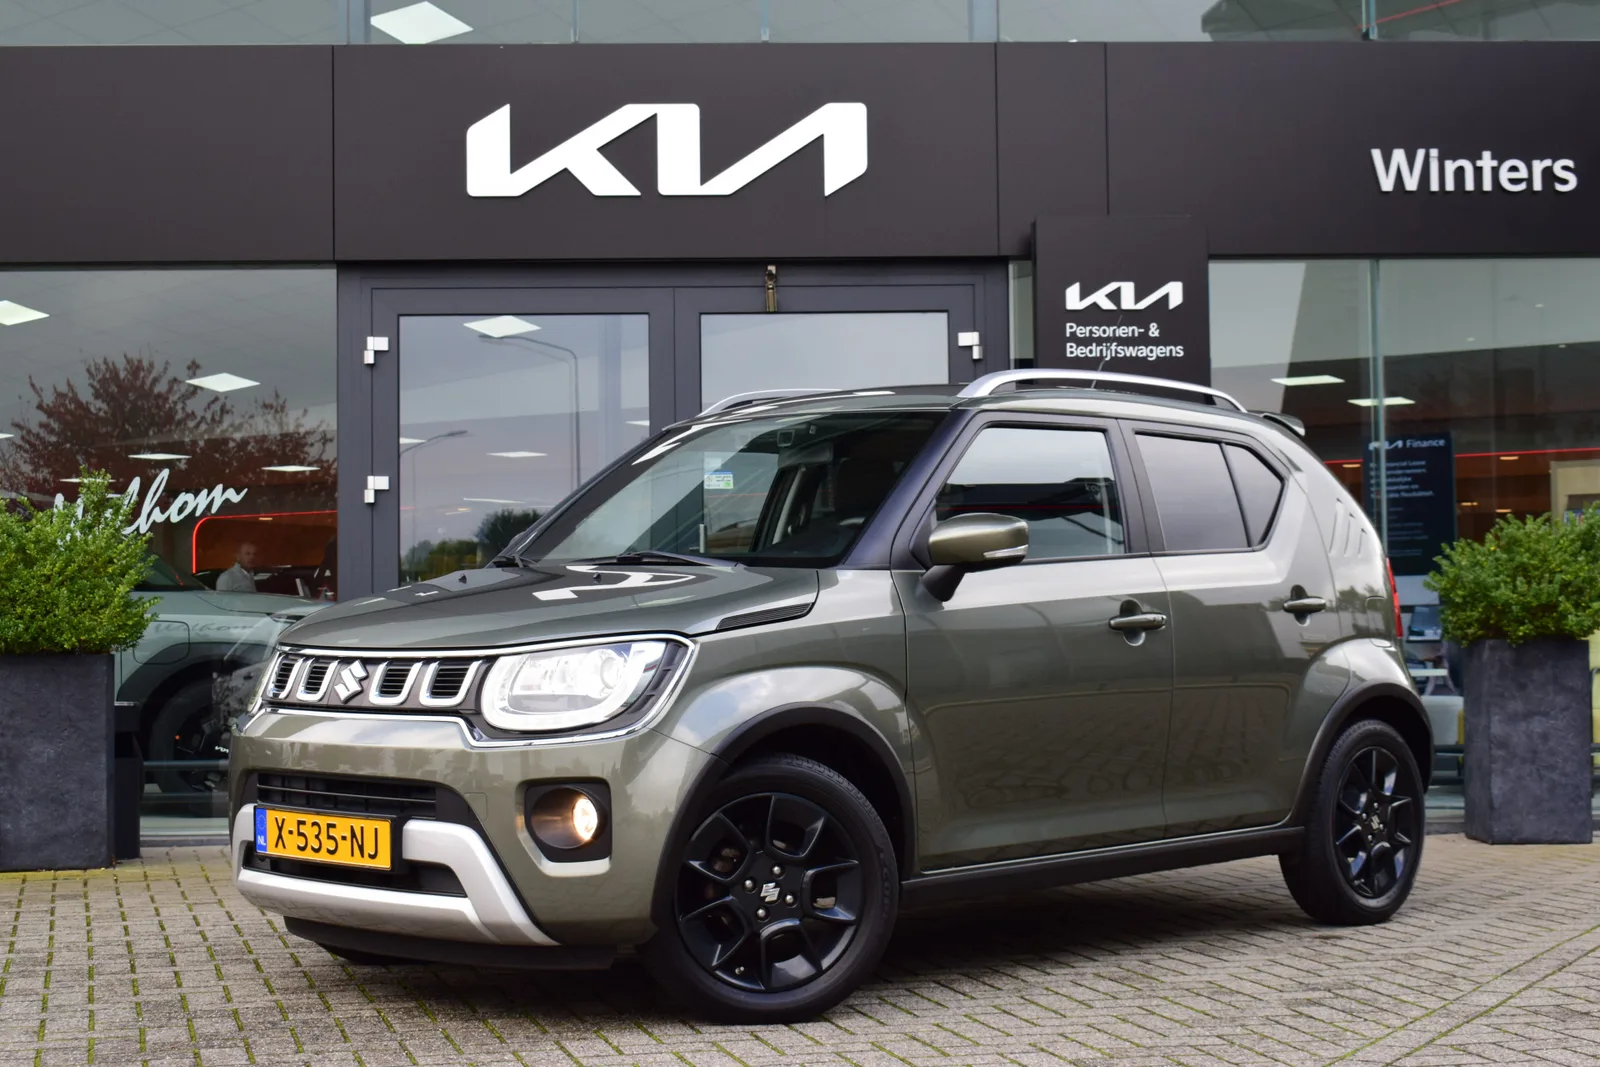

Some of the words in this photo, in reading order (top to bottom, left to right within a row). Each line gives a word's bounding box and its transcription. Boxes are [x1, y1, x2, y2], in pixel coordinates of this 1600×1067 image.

[466, 102, 868, 197] KIA
[1370, 148, 1578, 192] Winters
[1065, 281, 1183, 310] KIA
[1065, 322, 1145, 338] Personen-
[1148, 322, 1160, 337] &
[1066, 342, 1184, 361] Bedrijfswagens
[1406, 439, 1446, 447] Finance
[257, 835, 266, 845] NL
[274, 816, 379, 860] X-535-NJ
